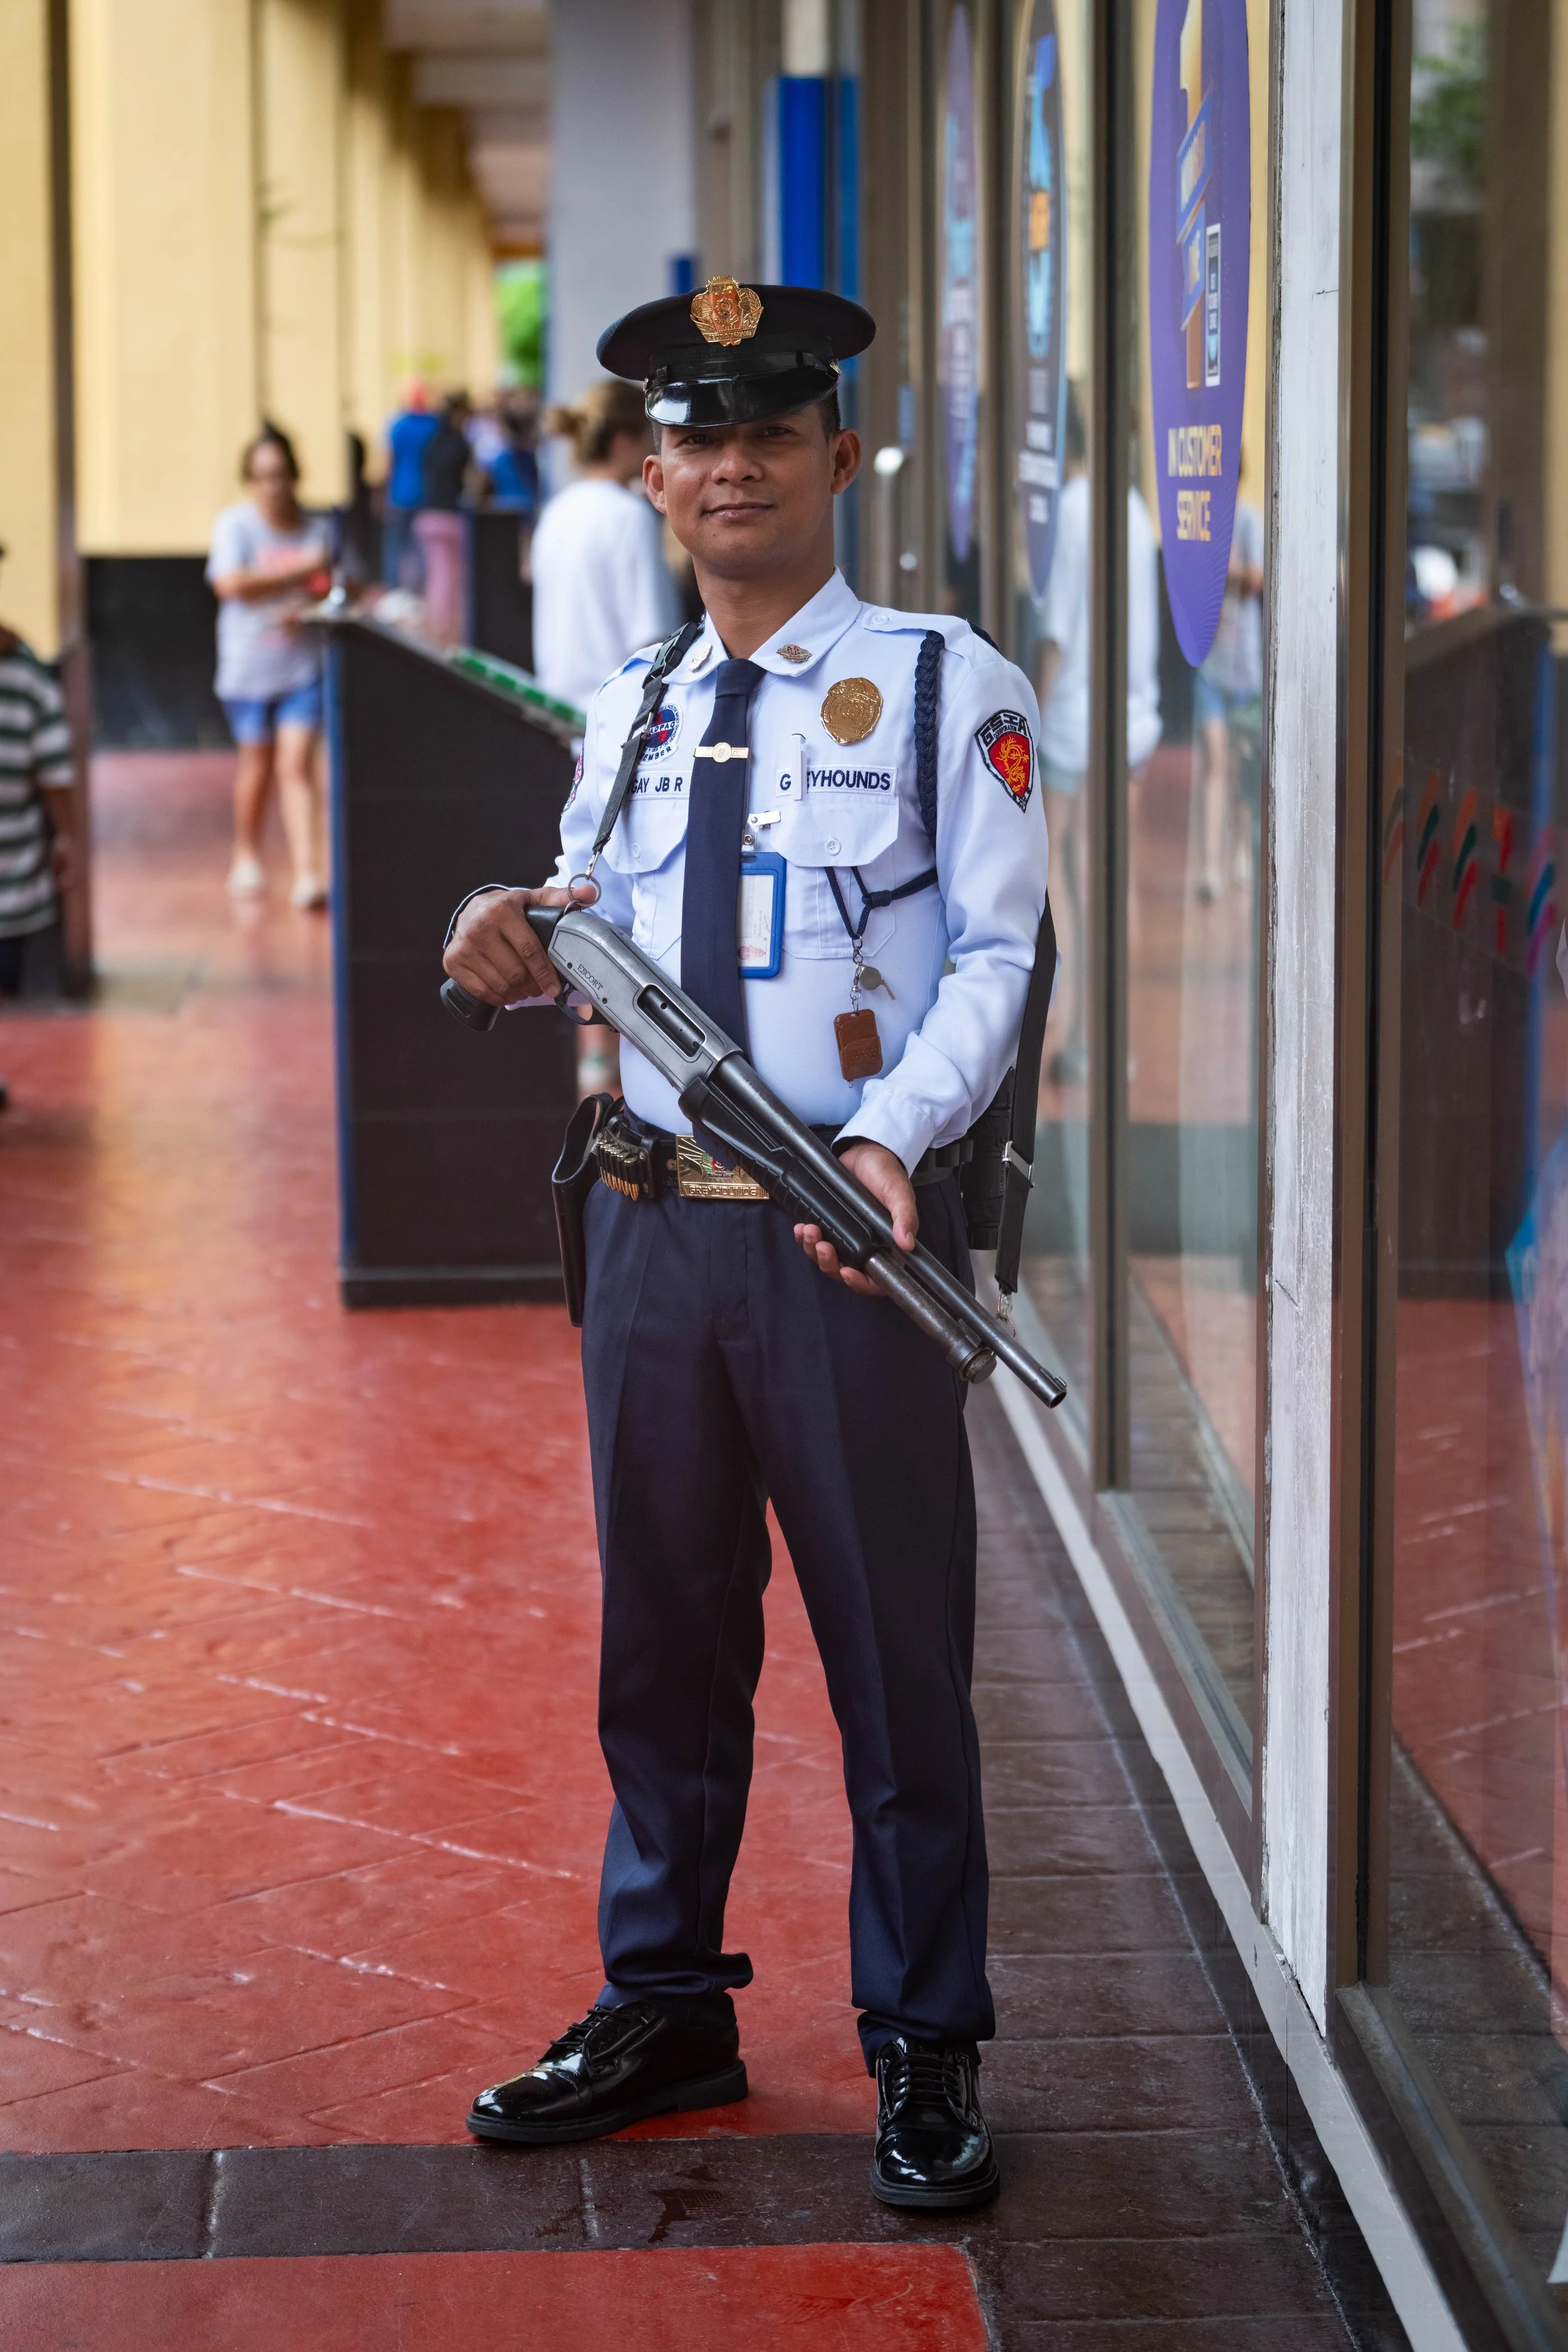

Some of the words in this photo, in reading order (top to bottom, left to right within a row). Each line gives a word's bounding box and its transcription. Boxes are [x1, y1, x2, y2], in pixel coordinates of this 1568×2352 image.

[1167, 428, 1177, 477] IN
[1178, 424, 1222, 477] CUSTOMER
[1177, 490, 1211, 541] SERVICE
[649, 721, 675, 734] ADPAO
[980, 713, 1027, 747] GSIA
[642, 746, 672, 761] EMBER
[655, 777, 670, 793] JB
[674, 777, 683, 792] R
[780, 770, 891, 790] GYHOUNDS
[577, 963, 604, 991] ESCORT
[689, 1185, 757, 1195] GREYHOUNDS
